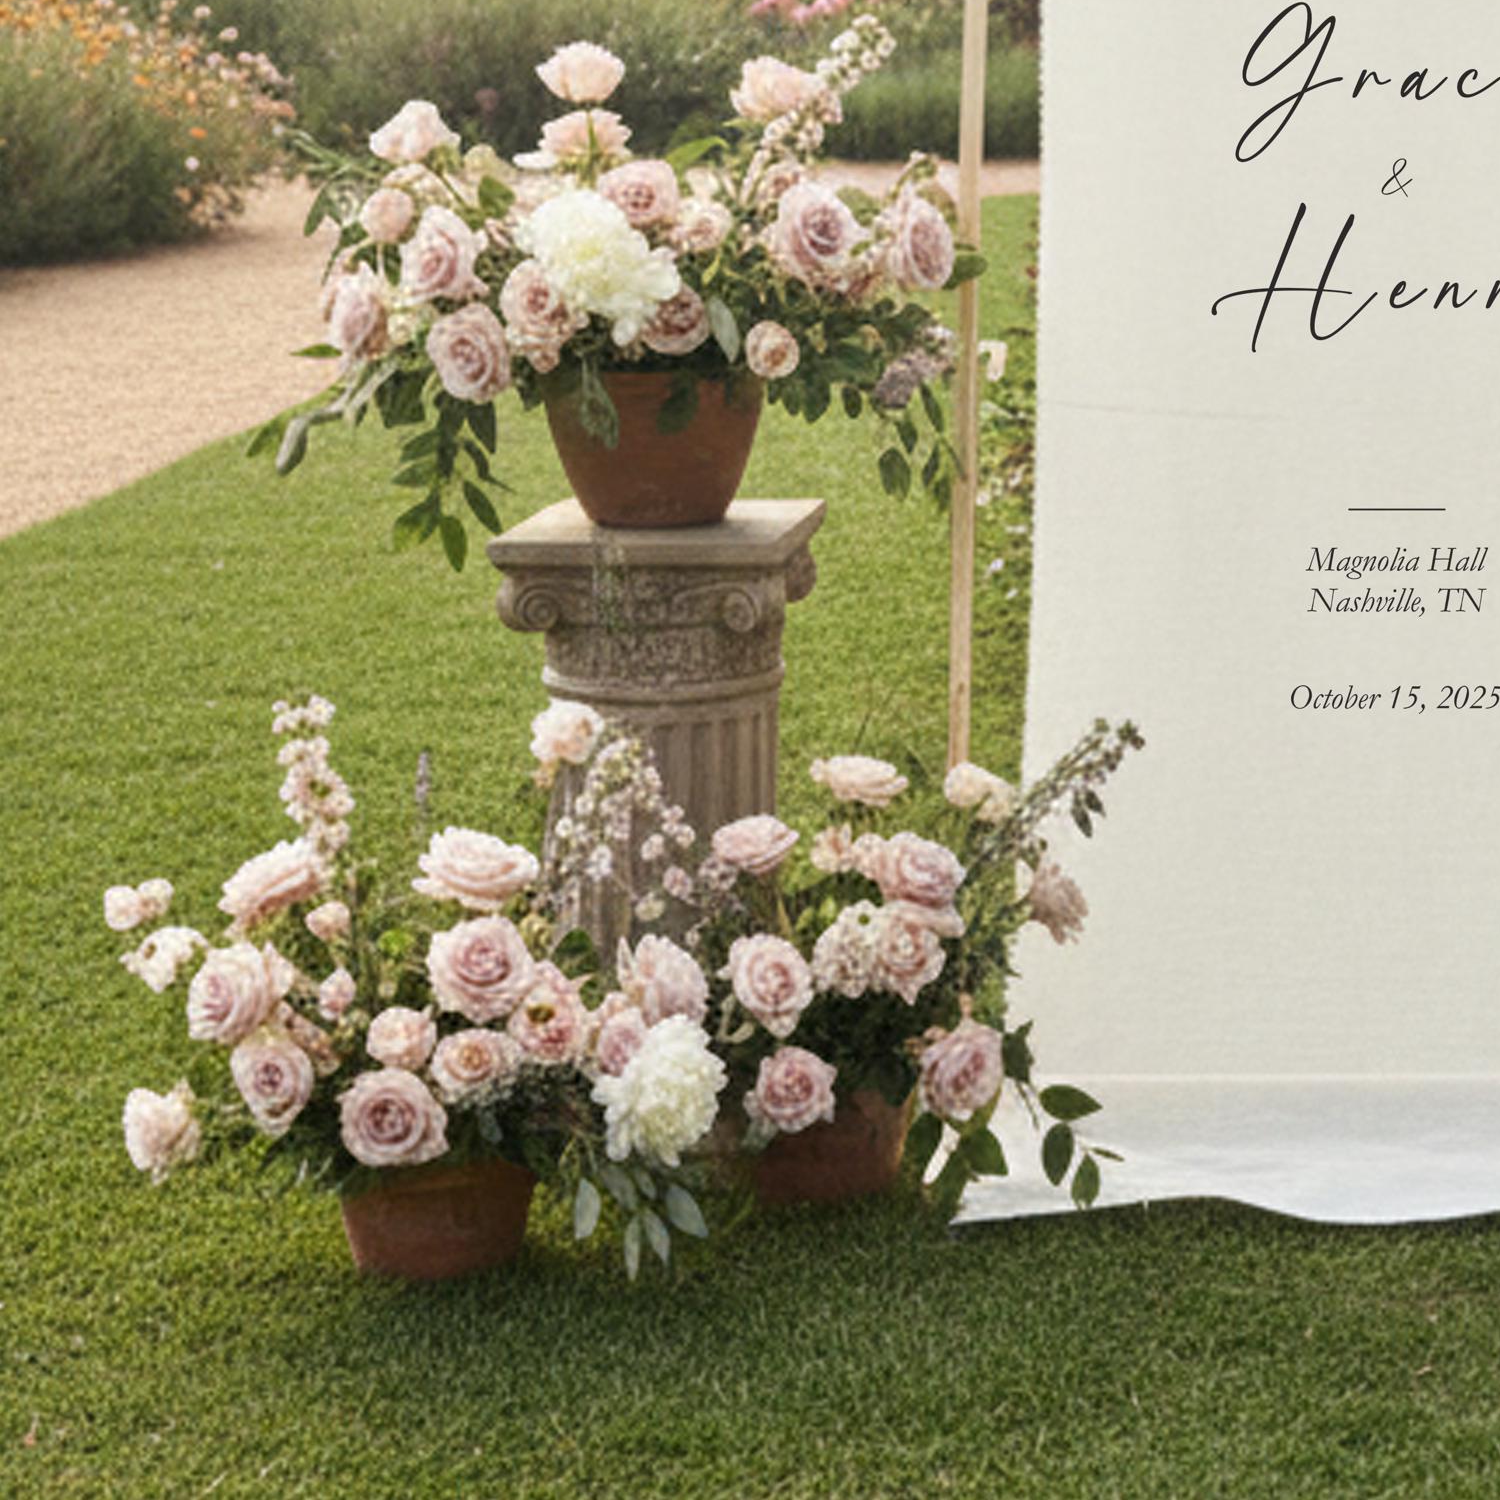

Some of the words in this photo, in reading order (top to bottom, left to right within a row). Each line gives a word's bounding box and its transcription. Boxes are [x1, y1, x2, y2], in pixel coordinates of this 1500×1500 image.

[1381, 158, 1413, 197] &
[1306, 547, 1420, 579] Magnolia
[1427, 547, 1488, 571] Hall
[1307, 588, 1425, 617] Nashville,
[1438, 588, 1487, 612] TN
[1291, 685, 1381, 709] October
[1392, 686, 1425, 714] 15,
